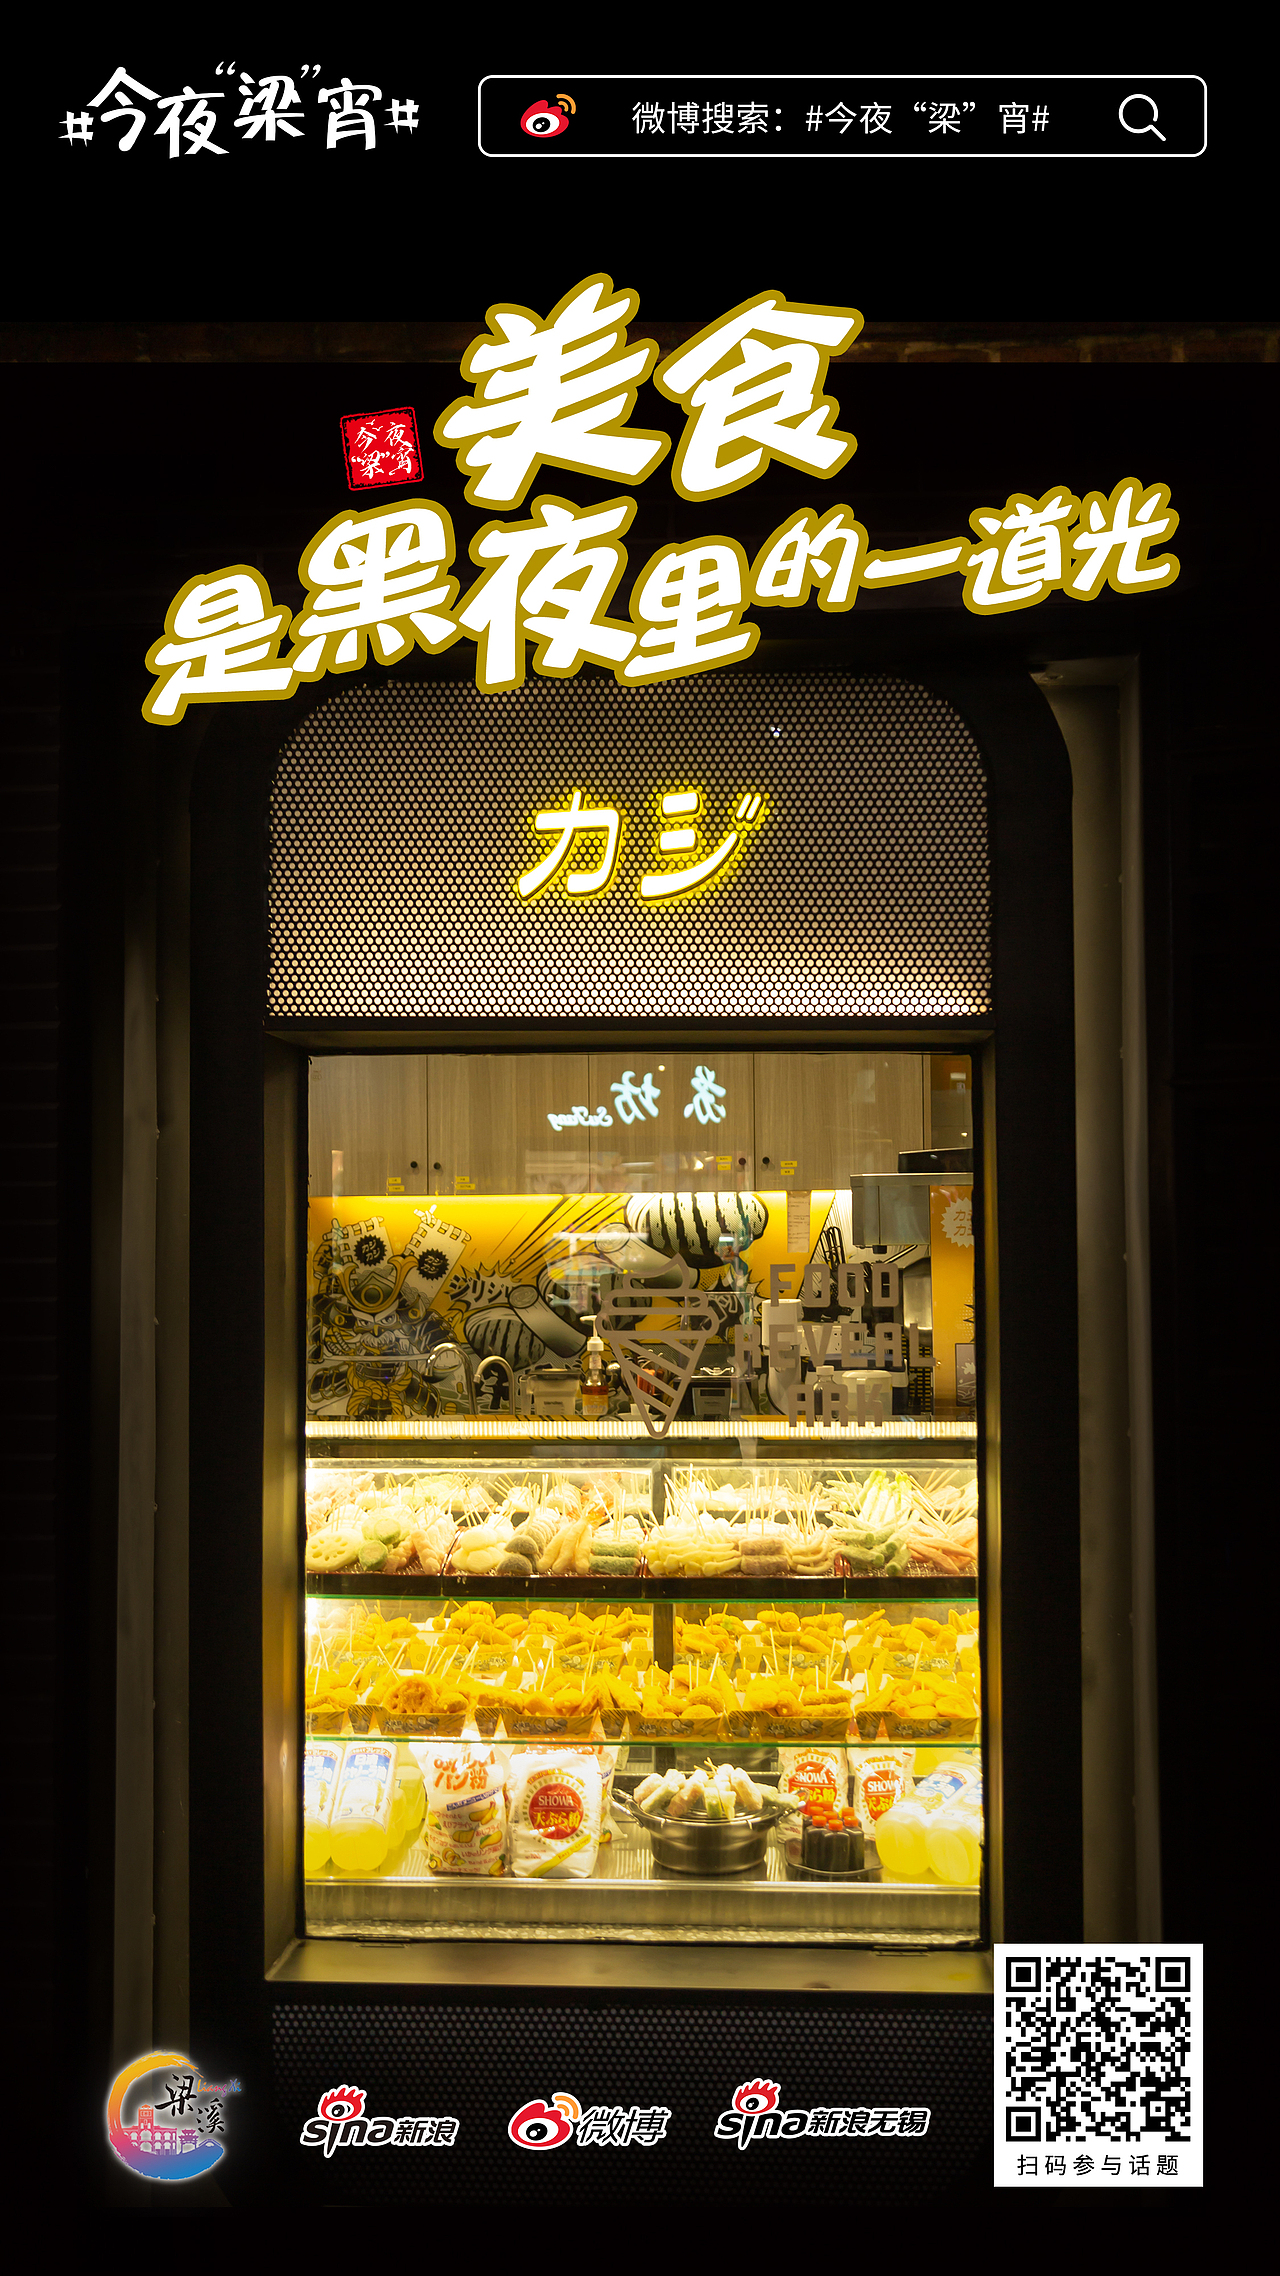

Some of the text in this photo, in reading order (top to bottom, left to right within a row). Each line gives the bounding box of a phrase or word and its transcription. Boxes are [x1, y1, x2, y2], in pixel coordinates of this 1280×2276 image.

[517, 789, 763, 900] カジ
[770, 1263, 899, 1307] FOOD
[734, 1322, 936, 1368] REVEAL
[789, 1384, 883, 1427] ARK
[538, 1795, 574, 1806] SHOWA
